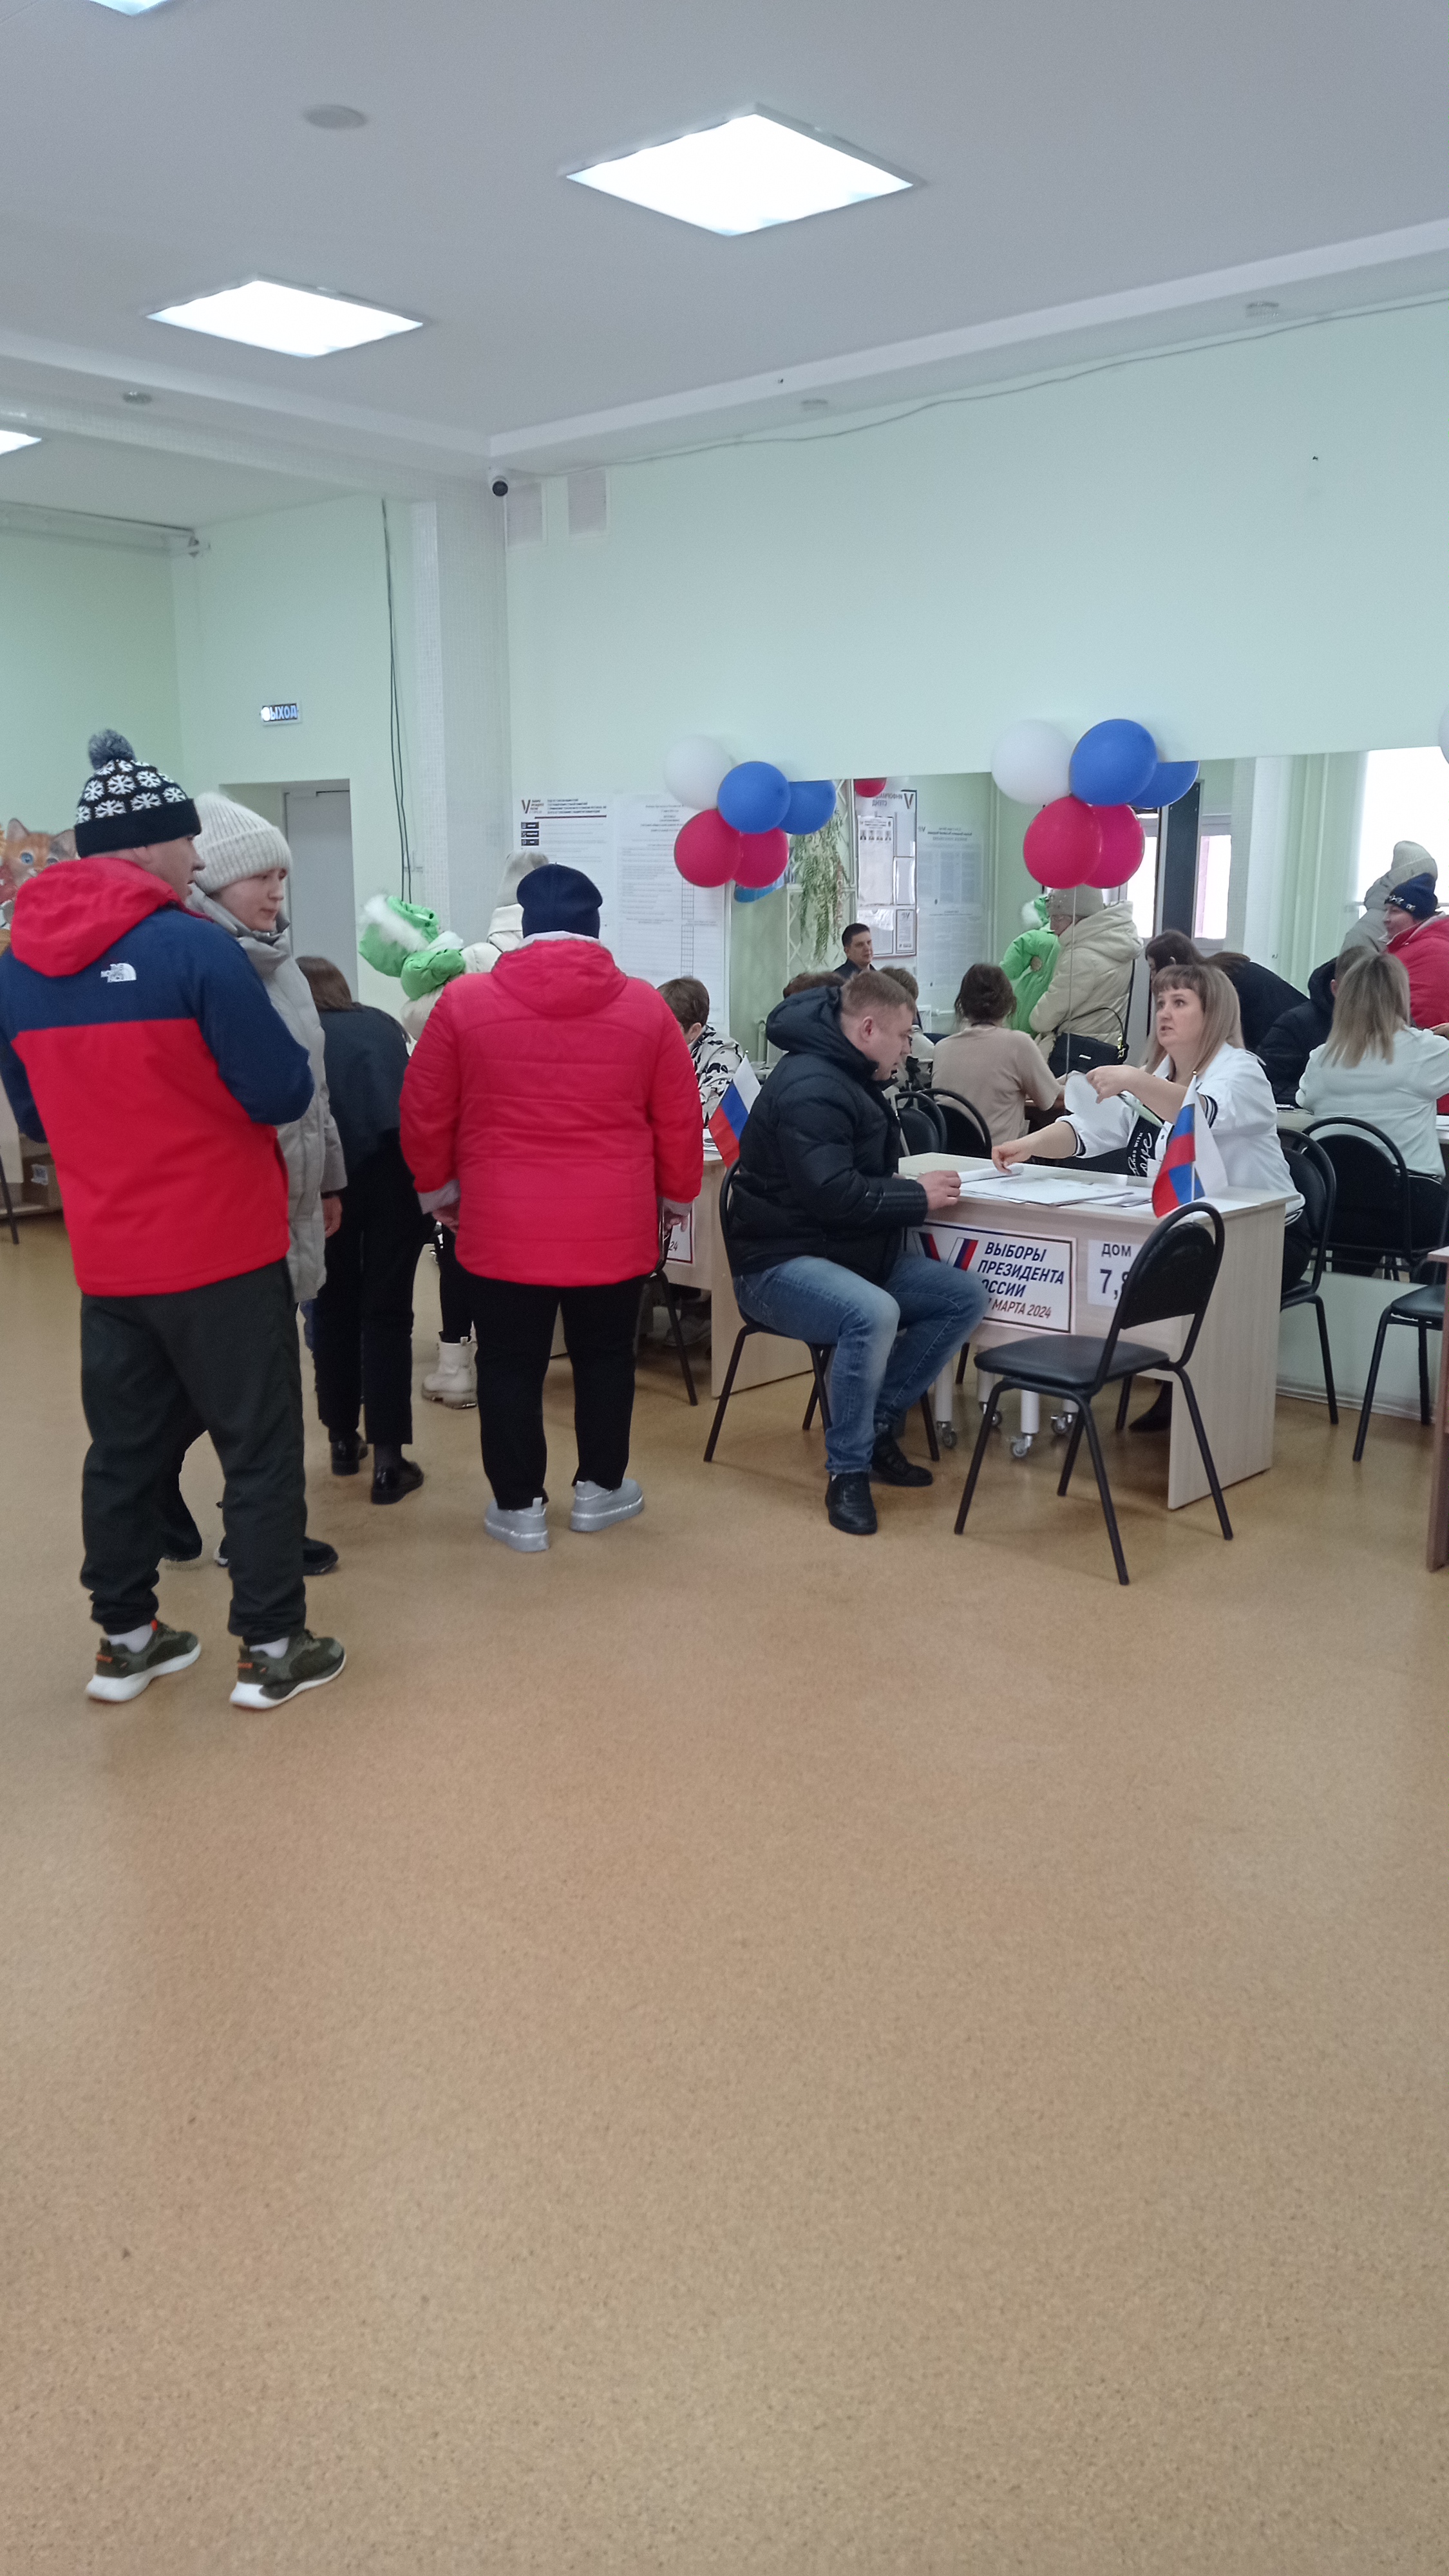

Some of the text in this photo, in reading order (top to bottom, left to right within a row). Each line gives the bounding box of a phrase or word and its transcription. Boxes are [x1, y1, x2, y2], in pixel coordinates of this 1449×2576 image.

[261, 705, 298, 721] ЫХОД
[668, 1241, 678, 1252] 24
[985, 1242, 1047, 1262] ВЫБОРЫ
[1101, 1243, 1132, 1258] ДОМ
[977, 1260, 1065, 1285] ПРЕЗИДЕНТА
[981, 1279, 1027, 1298] ОССИИ
[992, 1298, 1026, 1315] МАРТА
[1027, 1304, 1052, 1319] 2024
